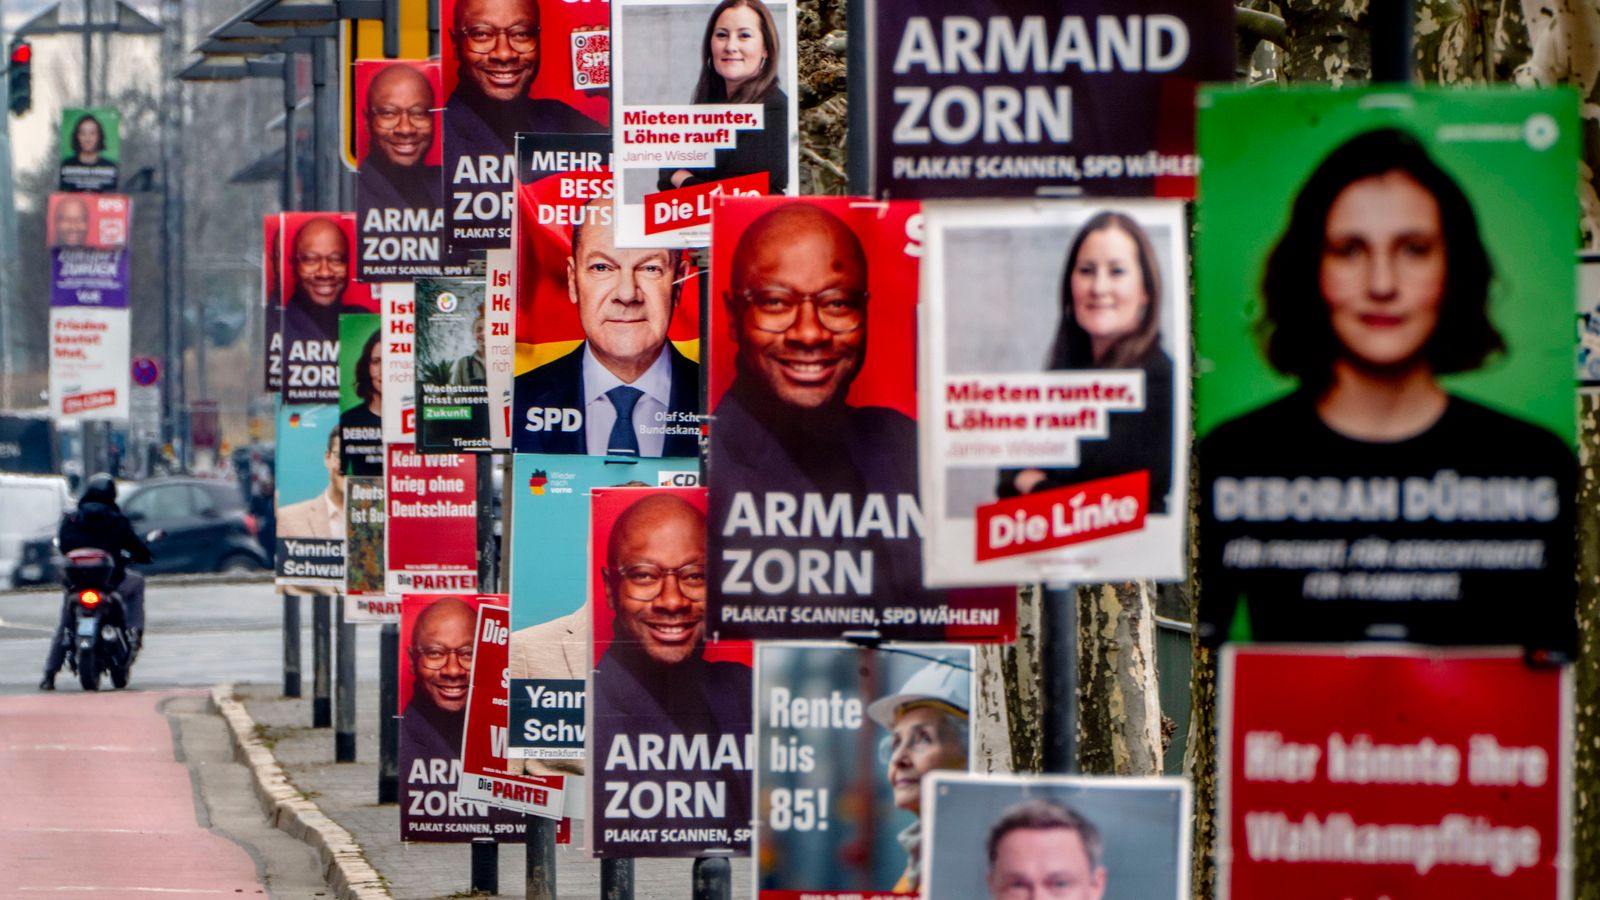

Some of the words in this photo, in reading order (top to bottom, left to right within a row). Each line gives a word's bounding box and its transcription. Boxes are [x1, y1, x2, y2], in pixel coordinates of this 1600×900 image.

[893, 14, 1190, 74] ARMAND
[623, 110, 689, 126] Mieten
[693, 110, 758, 127] runter,
[893, 86, 1073, 144] ZORN
[623, 129, 681, 145] Löhne
[684, 128, 729, 144] rauf!
[531, 151, 603, 172] MEHR
[623, 150, 662, 162] Janine
[665, 150, 709, 161] Wissler
[893, 156, 971, 178] PLAKAT
[975, 156, 1082, 181] SCANNEN,
[1083, 156, 1122, 177] SPD
[560, 178, 614, 199] BESS
[363, 208, 444, 232] ARMA
[538, 204, 612, 226] DEUTS
[654, 198, 694, 225] Die
[454, 228, 496, 238] PLAKAT
[363, 237, 439, 261] ZORN
[363, 266, 397, 275] PLAKAT
[398, 266, 443, 276] SCANNEN,
[444, 267, 462, 275] SPD
[391, 301, 415, 314] Ist
[390, 320, 415, 334] He
[491, 322, 509, 336] zu
[390, 342, 411, 353] zu
[424, 395, 452, 404] frisst
[947, 384, 1041, 402] Mieten
[1048, 383, 1135, 404] runter,
[426, 408, 469, 418] Zukunft
[525, 406, 583, 432] SPD
[655, 410, 677, 422] Olaf
[946, 410, 1028, 431] Löhne
[1034, 409, 1097, 430] rauf!
[640, 424, 700, 435] Bundeskanz
[392, 450, 421, 467] Kein
[425, 454, 465, 467] Welt-
[391, 475, 426, 496] krieg
[429, 475, 465, 493] ohne
[673, 473, 699, 487] CD
[1213, 476, 1399, 522] DEBORAH
[1403, 469, 1560, 522] DÜRING
[351, 507, 368, 523] ist
[391, 499, 477, 518] Deutschland
[722, 491, 924, 539] ARMAN
[988, 508, 1049, 550] Die
[1051, 490, 1139, 538] Linke
[397, 574, 412, 585] Die
[413, 575, 477, 589] PARTEI
[721, 548, 874, 595] ZORN
[721, 604, 788, 622] PLAKAT
[790, 605, 880, 627] SCANNEN,
[882, 607, 918, 625] SPD
[919, 605, 1000, 626] WÄHLEN!
[481, 618, 509, 646] Die
[769, 687, 863, 730] Rente
[523, 749, 538, 757] Für
[540, 749, 578, 757] Frankfurt
[769, 736, 816, 773] bis
[1245, 730, 1322, 783] Hier
[1327, 731, 1461, 786] könnte
[478, 777, 492, 791] Die
[492, 780, 549, 807] PARTEI
[604, 780, 727, 819] ZORN
[769, 787, 830, 832] 85!
[408, 822, 443, 832] PLAKAT
[444, 823, 493, 834] SCANNEN,
[494, 824, 514, 833] SPD
[604, 829, 658, 842] PLAKAT
[660, 829, 732, 844] SCANNEN,
[734, 829, 752, 842] SP
[1245, 811, 1541, 877] Wahlkampflüge
